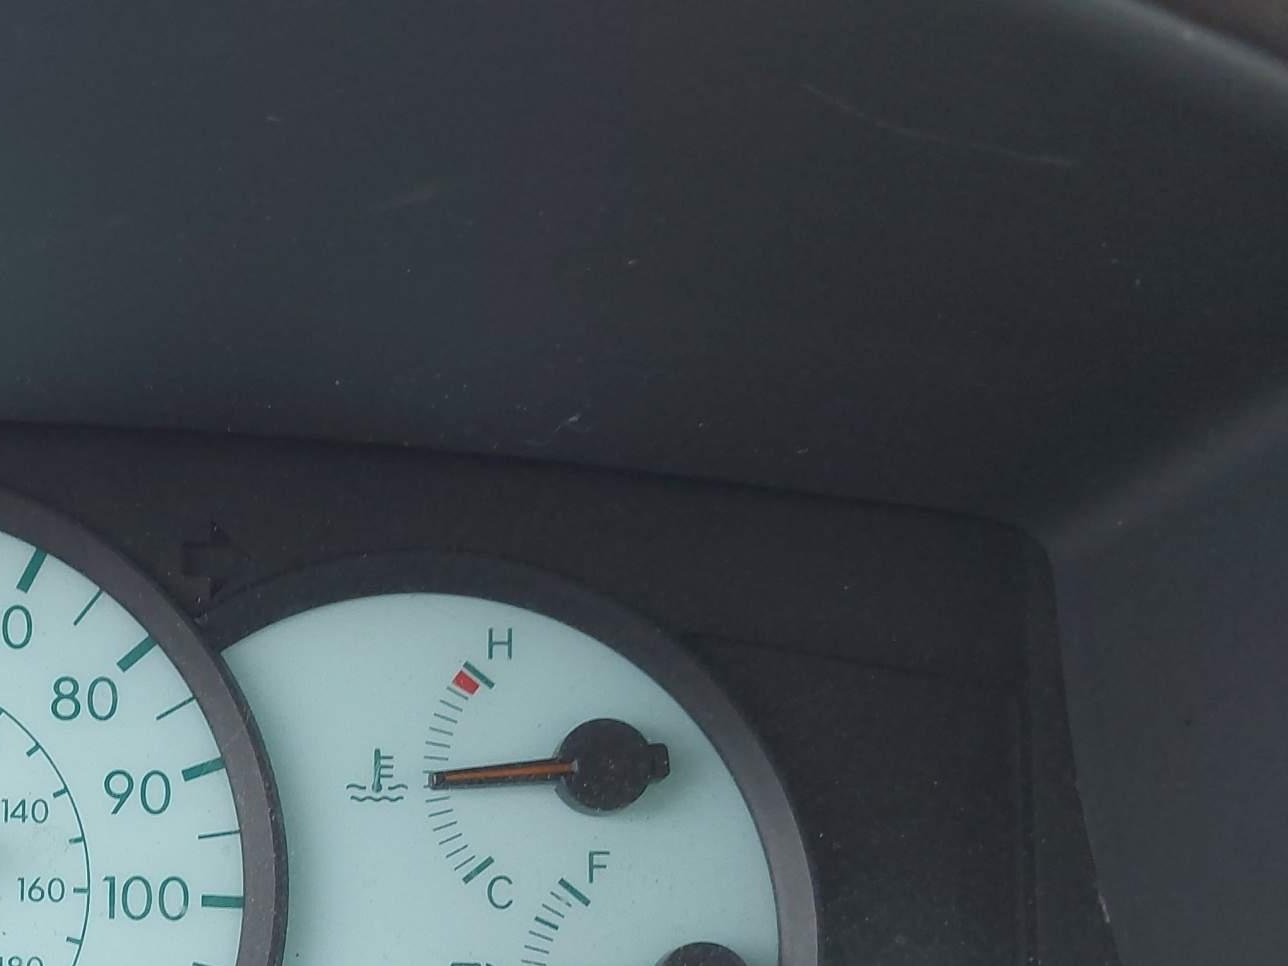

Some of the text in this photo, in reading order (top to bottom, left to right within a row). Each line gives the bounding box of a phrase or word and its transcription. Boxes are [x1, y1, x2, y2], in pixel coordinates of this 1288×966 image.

[488, 628, 513, 659] H
[51, 677, 118, 721] 80
[104, 770, 171, 815] 90
[2, 798, 49, 824] 140
[589, 851, 610, 883] F
[17, 877, 65, 902] 160
[103, 876, 190, 920] 100
[487, 876, 513, 909] C
